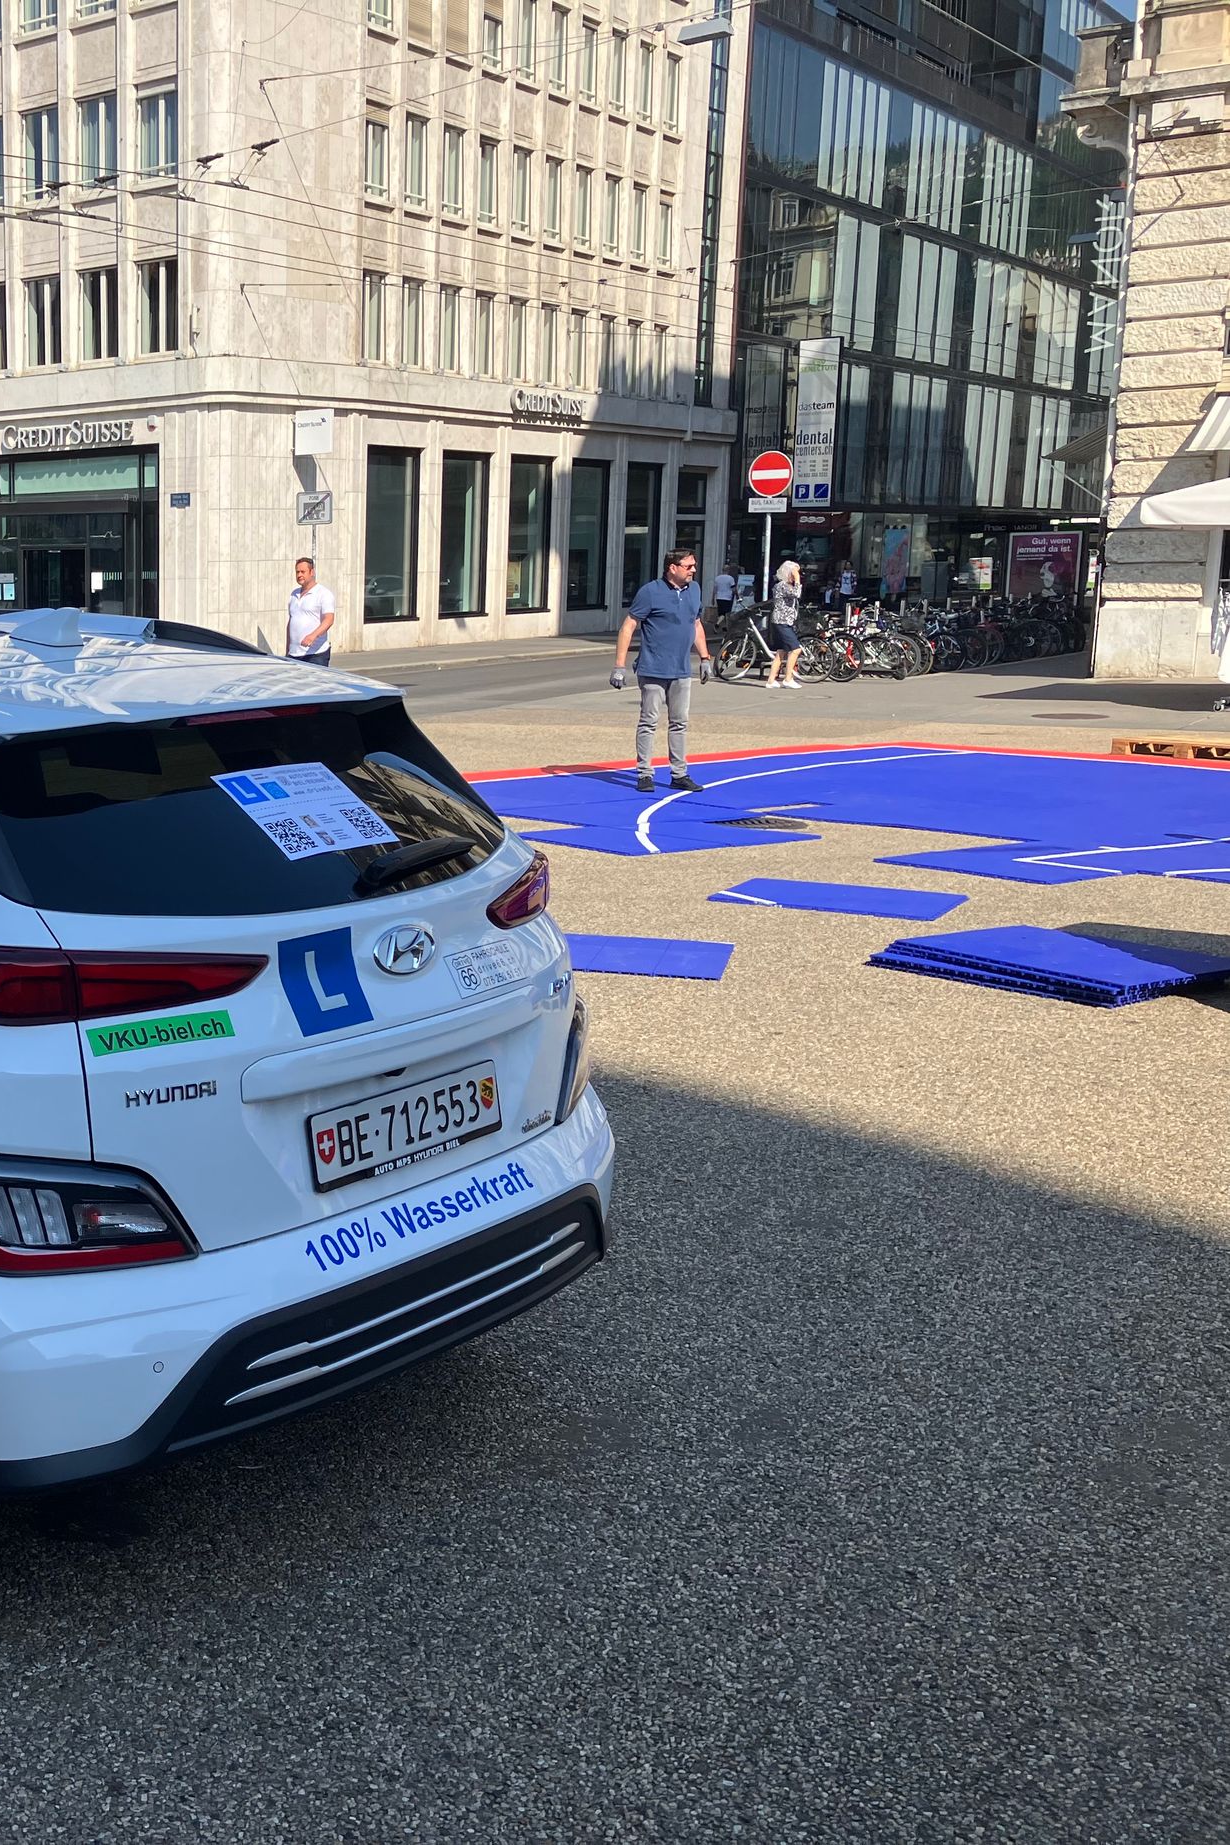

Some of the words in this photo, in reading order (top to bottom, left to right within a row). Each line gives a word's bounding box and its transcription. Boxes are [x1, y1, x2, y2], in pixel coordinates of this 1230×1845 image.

[512, 389, 552, 413] CREDIT
[799, 401, 835, 411] dasteam
[2, 424, 68, 450] CREDIT
[69, 420, 132, 445] SUISSE
[796, 428, 833, 446] dental
[796, 445, 833, 456] centers.ch
[1016, 545, 1046, 554] jemand
[1031, 538, 1048, 546] Gut,
[471, 943, 510, 960] FAHRSCHULE
[454, 958, 471, 968] DRIVE
[304, 950, 349, 1012] L
[460, 968, 478, 987] 66
[507, 969, 515, 979] 51
[98, 1018, 226, 1051] VKU-biel.ch
[125, 1080, 217, 1108] HYUNDAI
[374, 1161, 394, 1177] AUTO
[396, 1155, 411, 1170] MPS
[413, 1144, 445, 1163] HYUNDAI
[446, 1139, 460, 1153] BIEL
[305, 1217, 387, 1272] 100%
[380, 1162, 534, 1240] Wasserkraft
